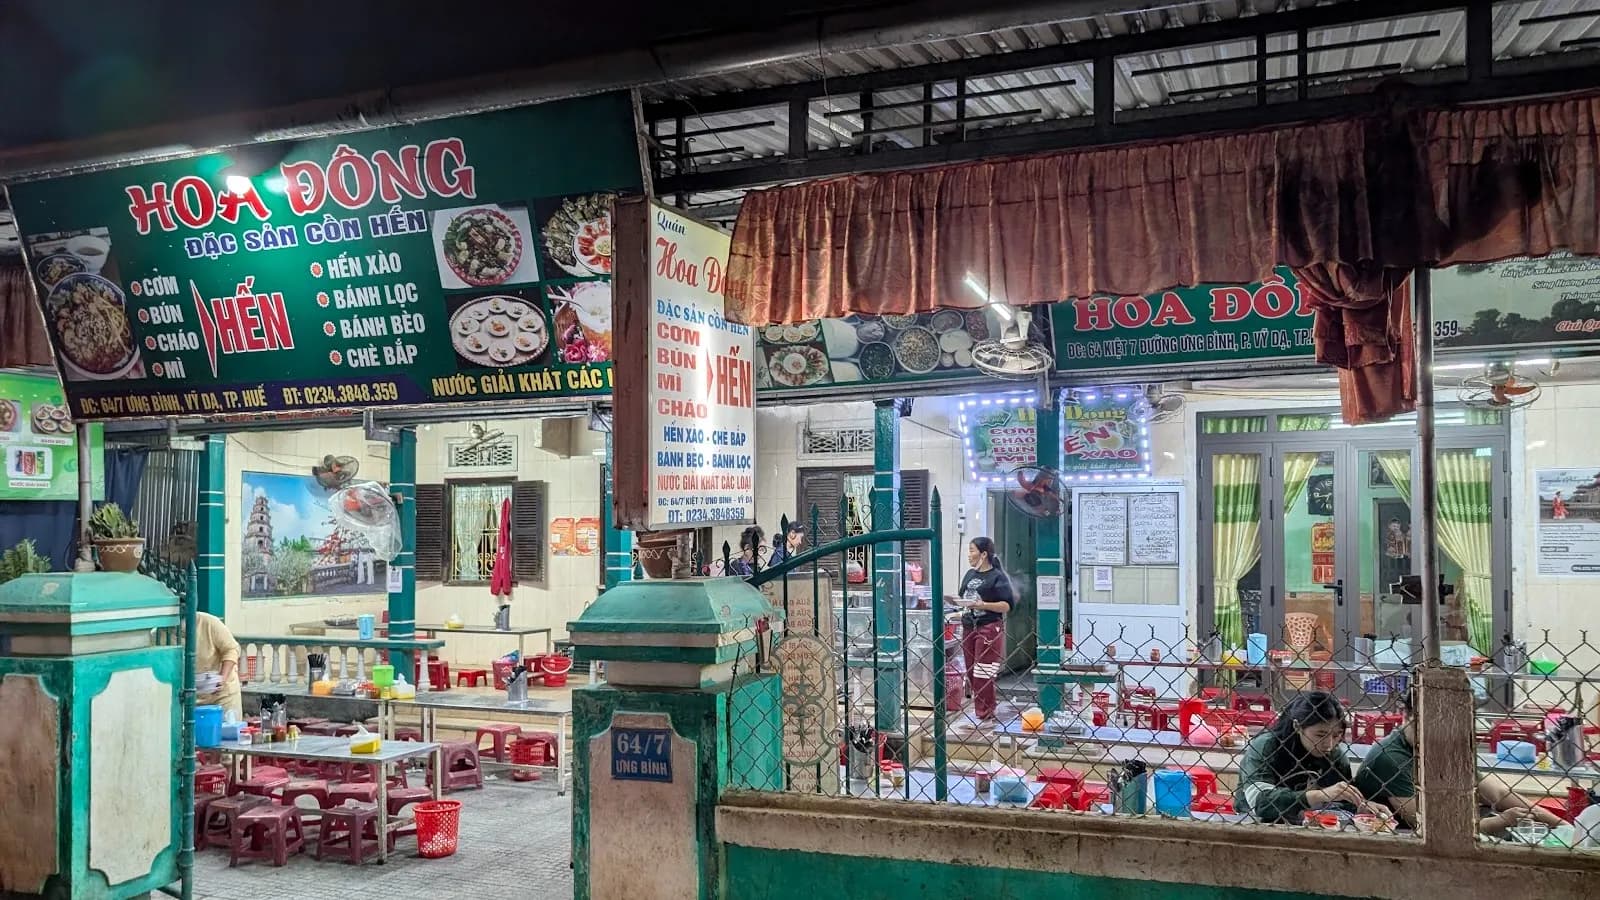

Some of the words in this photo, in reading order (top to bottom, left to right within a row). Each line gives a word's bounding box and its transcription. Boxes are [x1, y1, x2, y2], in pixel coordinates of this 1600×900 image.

[125, 175, 271, 235] HOA
[280, 137, 477, 216] ĐÔNG
[185, 231, 237, 260] ĐẶC
[243, 222, 297, 252] SẢN
[305, 213, 362, 245] CỒN
[369, 205, 428, 238] HẾN
[657, 210, 686, 236] Quán
[326, 251, 363, 279] HẾN
[365, 249, 402, 276] XÀO
[656, 237, 698, 288] Hoa
[142, 275, 180, 297] CƠM
[333, 284, 382, 309] BÁNH
[384, 282, 419, 308] LỌC
[149, 301, 184, 325] BÚN
[210, 275, 295, 355] HẾN
[340, 314, 388, 339] BÁNH
[390, 310, 426, 335] BÈO
[657, 298, 681, 321] ĐẶC
[684, 302, 705, 325] SẢN
[708, 308, 728, 332] CỒN
[1073, 291, 1196, 331] HOA
[157, 328, 200, 351] CHÁO
[657, 322, 701, 347] CƠM
[1067, 342, 1087, 359] ĐC:
[1087, 342, 1103, 358] 64
[1103, 337, 1128, 360] KIỆT
[1129, 339, 1137, 356] 7
[1139, 333, 1179, 356] ĐƯỜNG
[1179, 333, 1205, 352] ƯNG
[1206, 329, 1239, 352] BÌNH,
[1241, 331, 1252, 349] P.
[1252, 327, 1269, 349] VỸ
[1270, 329, 1292, 351] DẠ,
[346, 343, 381, 368] CHÈ
[383, 338, 418, 366] BẮP
[657, 347, 697, 370] BÚN
[163, 356, 187, 379] MÌ
[432, 372, 477, 397] NƯỚC
[481, 368, 516, 394] GIẢI
[518, 366, 563, 391] KHÁT
[567, 364, 603, 389] CÁC
[716, 345, 751, 408] HẾN
[304, 381, 398, 404] 0234.3848.359
[657, 373, 682, 393] MÌ
[151, 391, 184, 412] BÌNH,
[223, 391, 241, 408] TP.
[242, 383, 268, 407] HUẾ
[657, 396, 709, 419] CHÁO
[663, 420, 684, 443] HẾN
[685, 424, 704, 444] XÀO
[712, 427, 730, 446] CHÈ
[730, 425, 746, 447] BẮP
[657, 446, 683, 468] BÁNH
[686, 448, 704, 469] BÈO
[712, 449, 735, 469] BÁNH
[736, 455, 751, 473] LỌC
[657, 471, 681, 491] NƯỚC
[682, 470, 699, 490] GIẢI
[700, 474, 720, 490] KHÁT
[721, 474, 735, 490] CÁC
[736, 475, 751, 493] LOẠI
[700, 497, 704, 505] 7
[617, 733, 666, 755] 64/7
[641, 758, 668, 776] BÌNH
